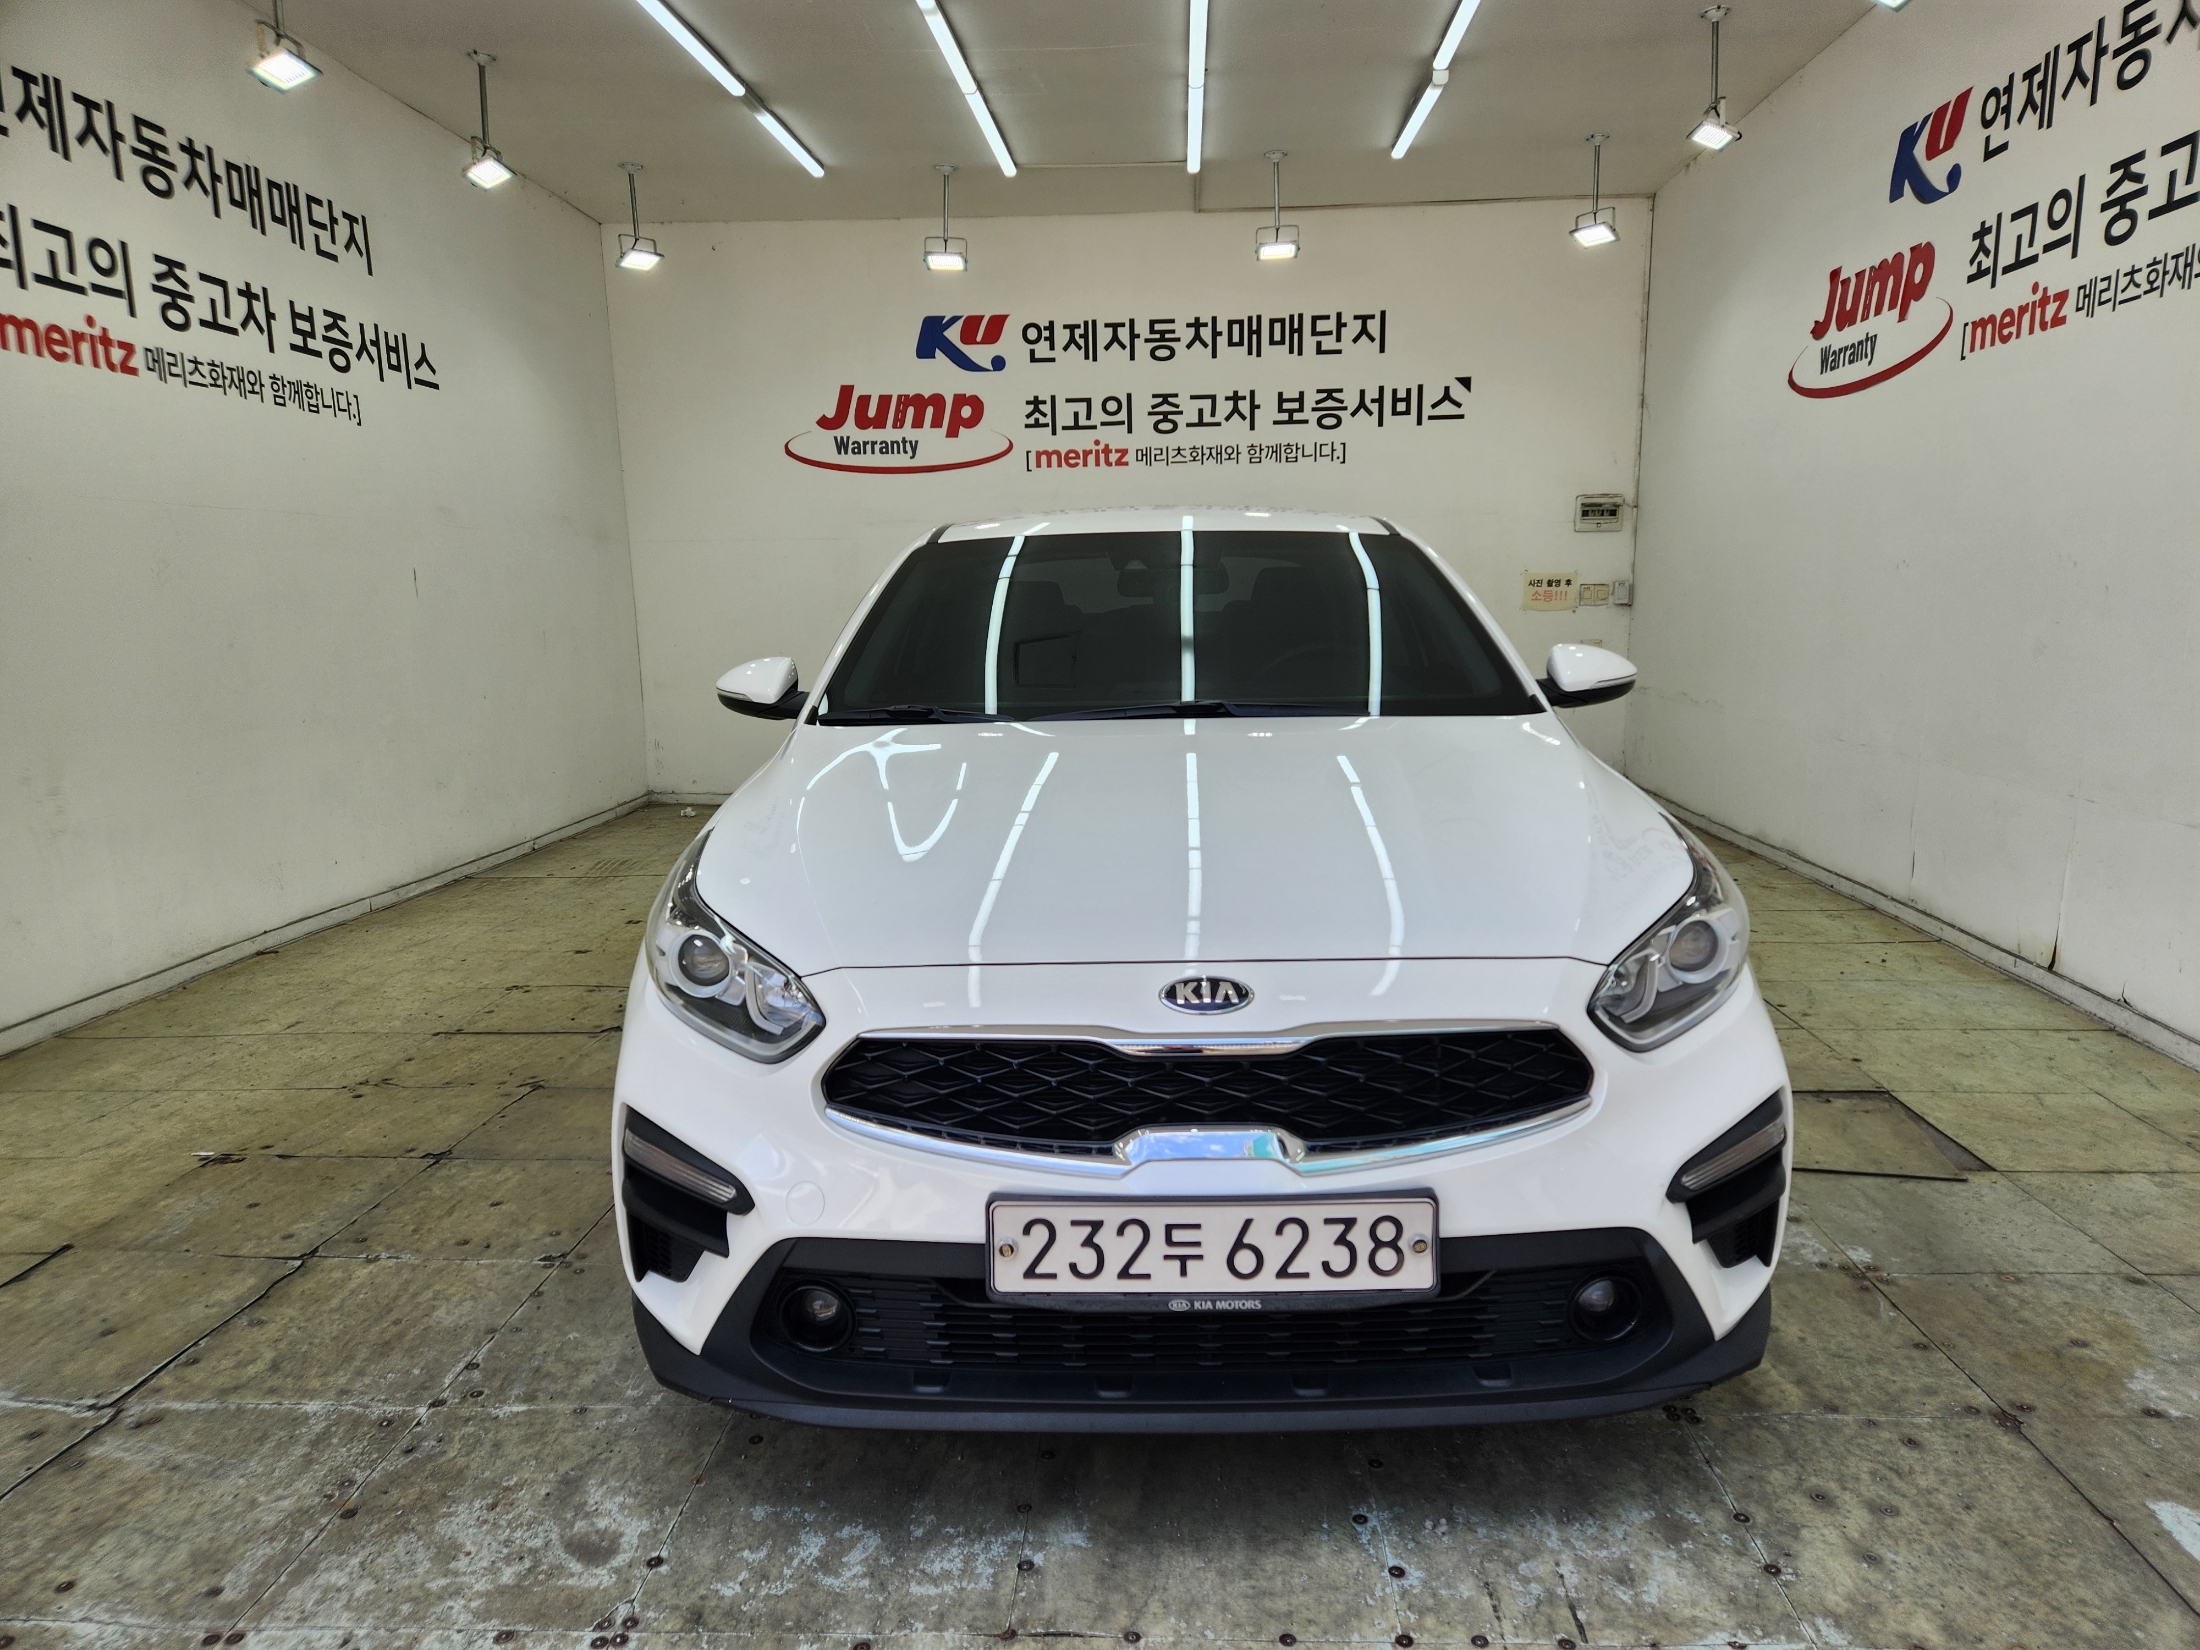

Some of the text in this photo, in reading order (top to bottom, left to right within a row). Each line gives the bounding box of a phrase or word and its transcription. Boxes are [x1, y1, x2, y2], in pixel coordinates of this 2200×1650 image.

[0, 66, 373, 276] 제자동차매매단지
[1966, 173, 2086, 288] 최고의
[1810, 241, 1935, 340] Jump
[2075, 243, 2200, 318] 메리츠화재
[151, 253, 276, 353] 중고차
[289, 300, 440, 390] 보증서비스
[1022, 310, 1386, 363] 연제자동차매매단지
[0, 314, 361, 426] meritz 메리츠화재와 함께합니다.]
[1820, 332, 1878, 375] Warranty
[816, 385, 984, 438] Jump
[1025, 384, 1465, 436] 최고의 중고차 보증서비스
[834, 436, 918, 459] Warranty
[1135, 444, 1242, 467] 메리츠화재와
[1247, 441, 1346, 464] 함께합니다.]
[1528, 579, 1543, 587] 사진
[1565, 579, 1572, 587] 후
[1531, 590, 1568, 602] 소등!!!
[1174, 981, 1239, 1004] KIA
[1226, 1215, 1405, 1280] 6238
[1194, 1301, 1213, 1310] KIA
[1216, 1300, 1262, 1310] MOTORS
